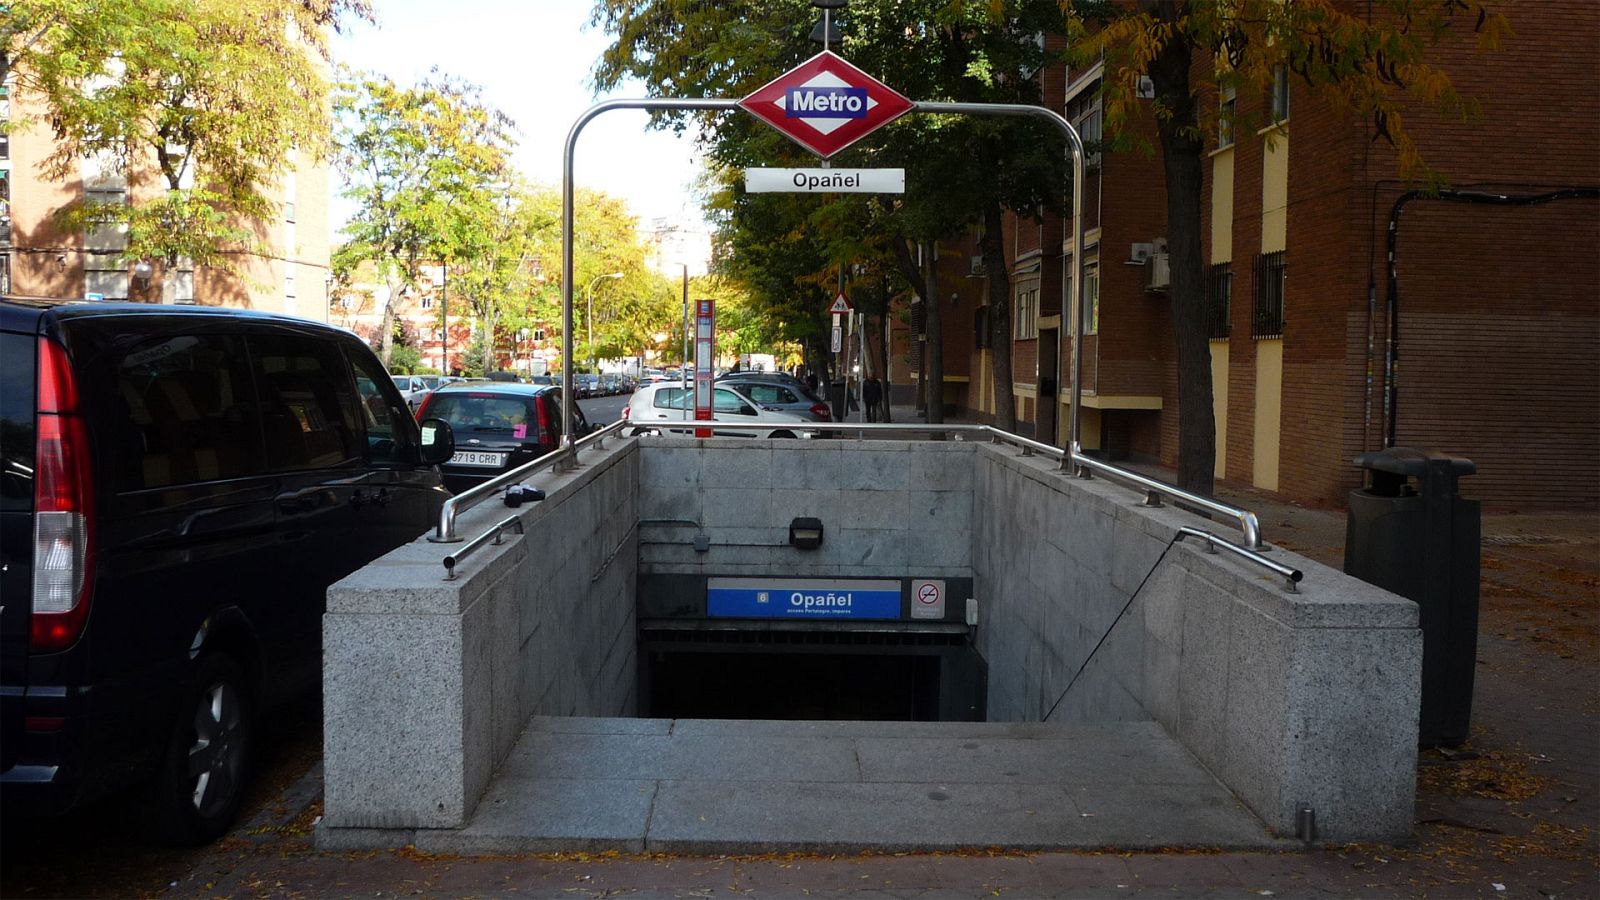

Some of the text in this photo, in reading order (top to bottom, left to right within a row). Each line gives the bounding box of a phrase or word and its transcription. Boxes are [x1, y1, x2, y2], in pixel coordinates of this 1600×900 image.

[793, 91, 862, 111] Metro
[793, 173, 860, 190] Opañel
[452, 453, 497, 464] 8719 CRR
[791, 592, 852, 608] Opañel
